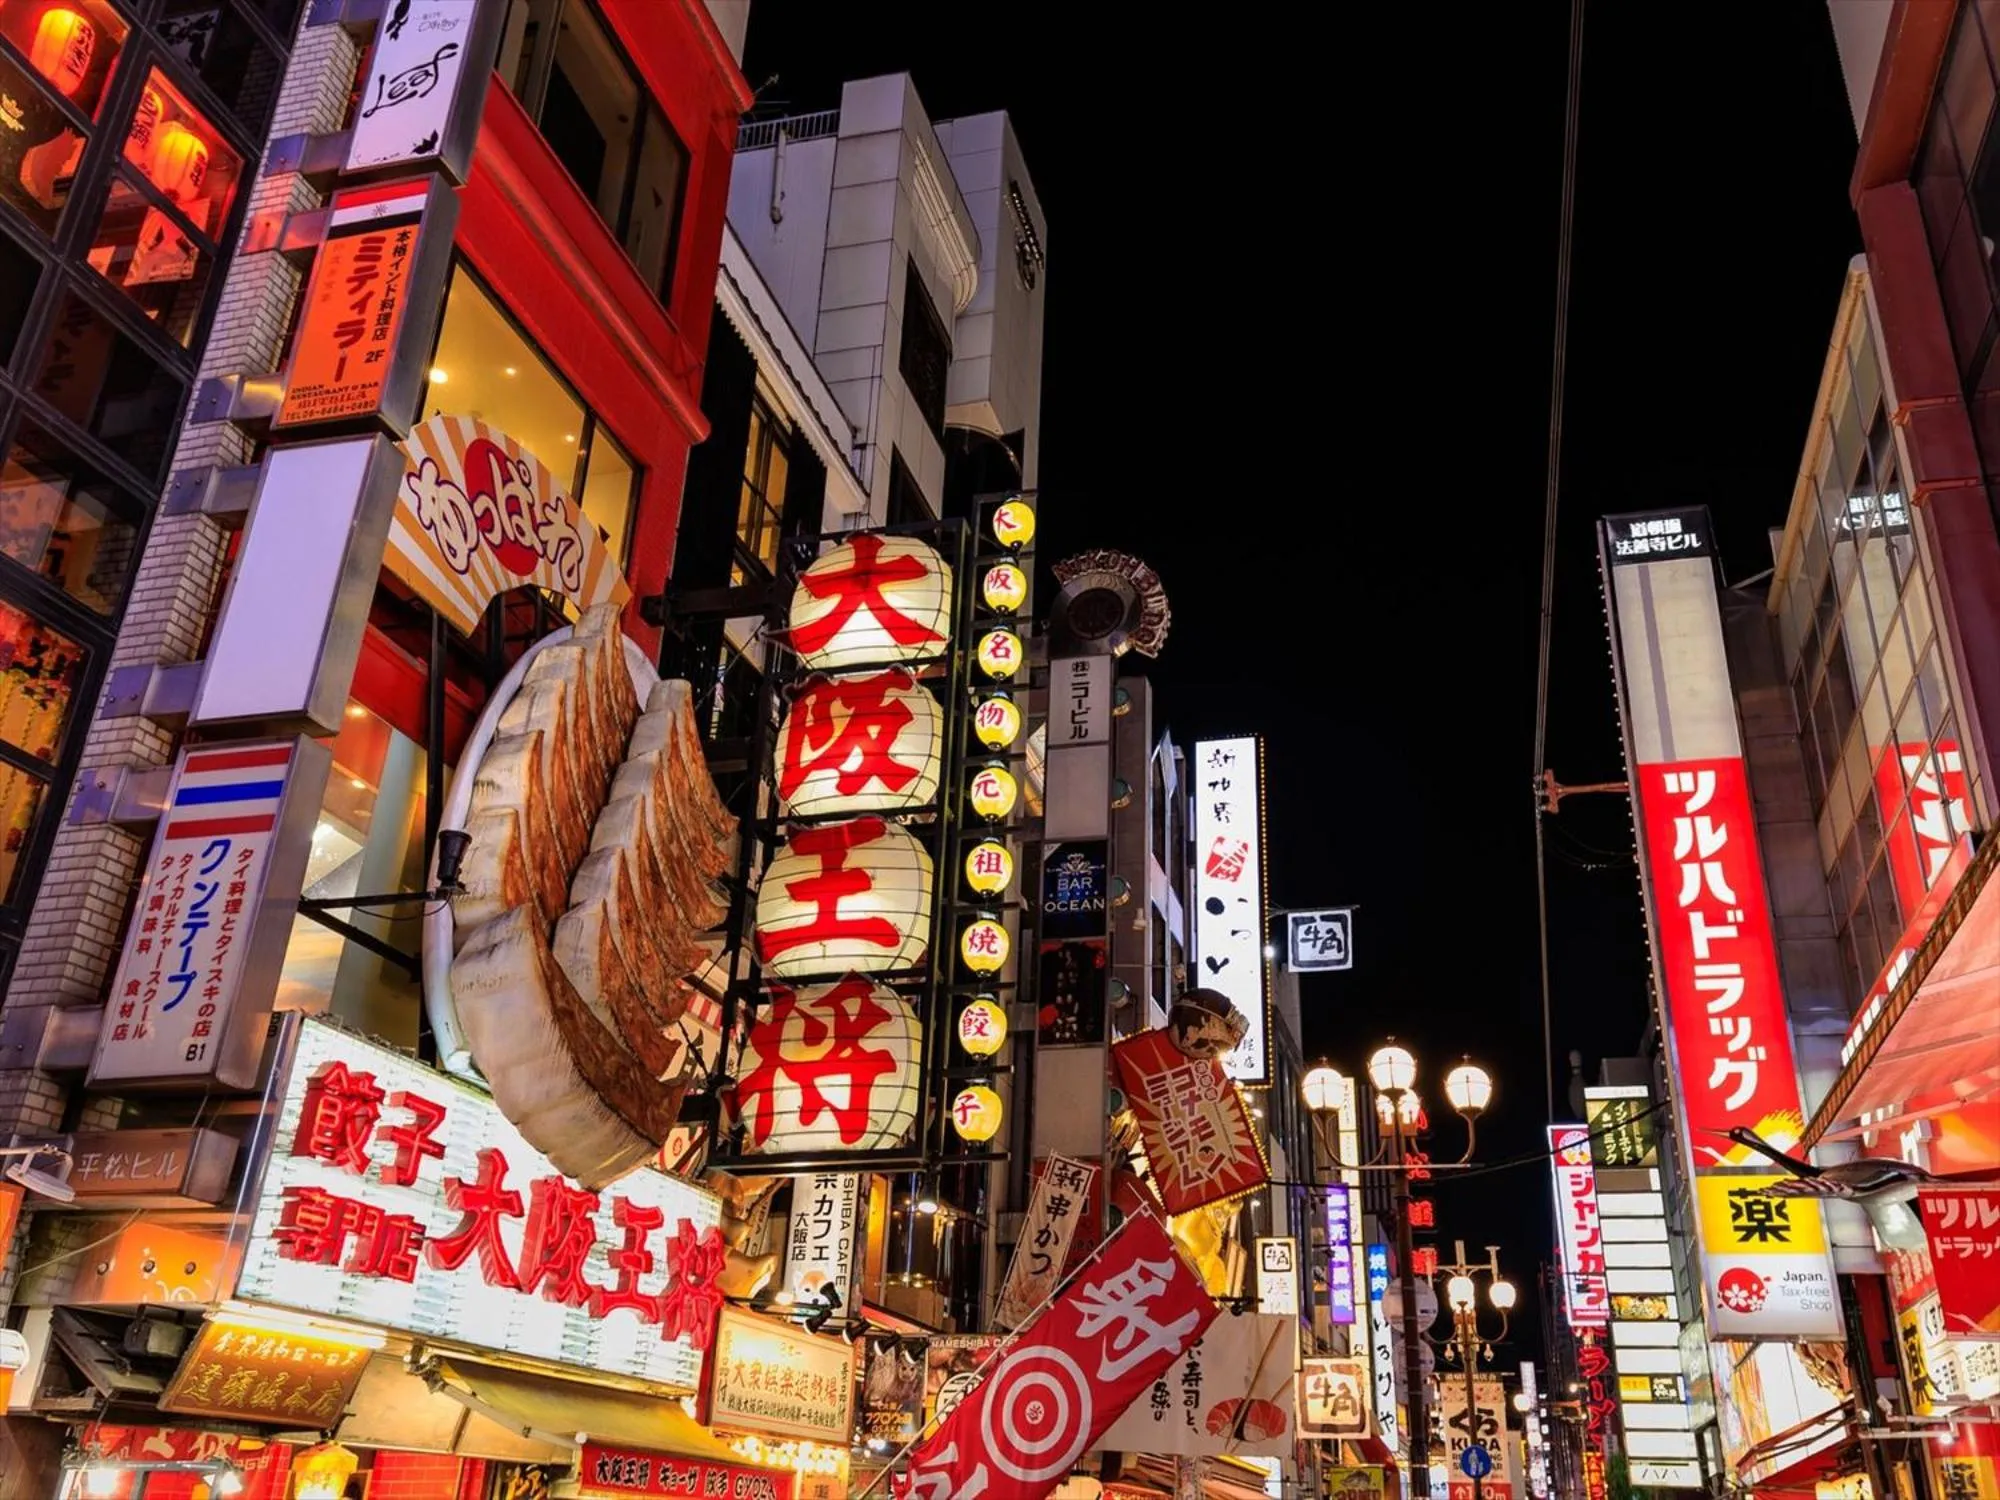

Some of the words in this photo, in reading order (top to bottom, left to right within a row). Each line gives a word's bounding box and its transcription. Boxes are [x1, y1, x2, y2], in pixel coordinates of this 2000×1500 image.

[333, 236, 387, 382] ミティラー
[372, 229, 413, 342] 本格インド料理店
[364, 349, 386, 364] 2F
[1044, 898, 1105, 914] OCEAN
[1057, 876, 1093, 892] BAR
[132, 852, 194, 1039] タイカルチャースクール
[163, 838, 232, 1012] クンテープ
[191, 848, 254, 1037] タイ料理とタイスキの店
[1299, 924, 1342, 956] 牛角
[1663, 770, 1768, 1111] ツルハドラッグ
[185, 1042, 206, 1062] B1
[293, 1061, 446, 1186] 餃子
[273, 1187, 427, 1283] 専門店
[791, 1212, 811, 1262] 大阪店
[1727, 1187, 1792, 1243] 薬
[425, 1148, 726, 1350] 大阪王将
[835, 1238, 850, 1287] CAFE
[1934, 1236, 2000, 1258] ドラッ
[1779, 1286, 1830, 1297] Tax-free
[1800, 1300, 1832, 1312] Shop
[1308, 1375, 1358, 1417] 牛角
[596, 1452, 650, 1491] 大阪王将
[659, 1463, 700, 1492] ギョーザ
[705, 1467, 729, 1497] 餃子
[734, 1472, 777, 1500] GYOZA
